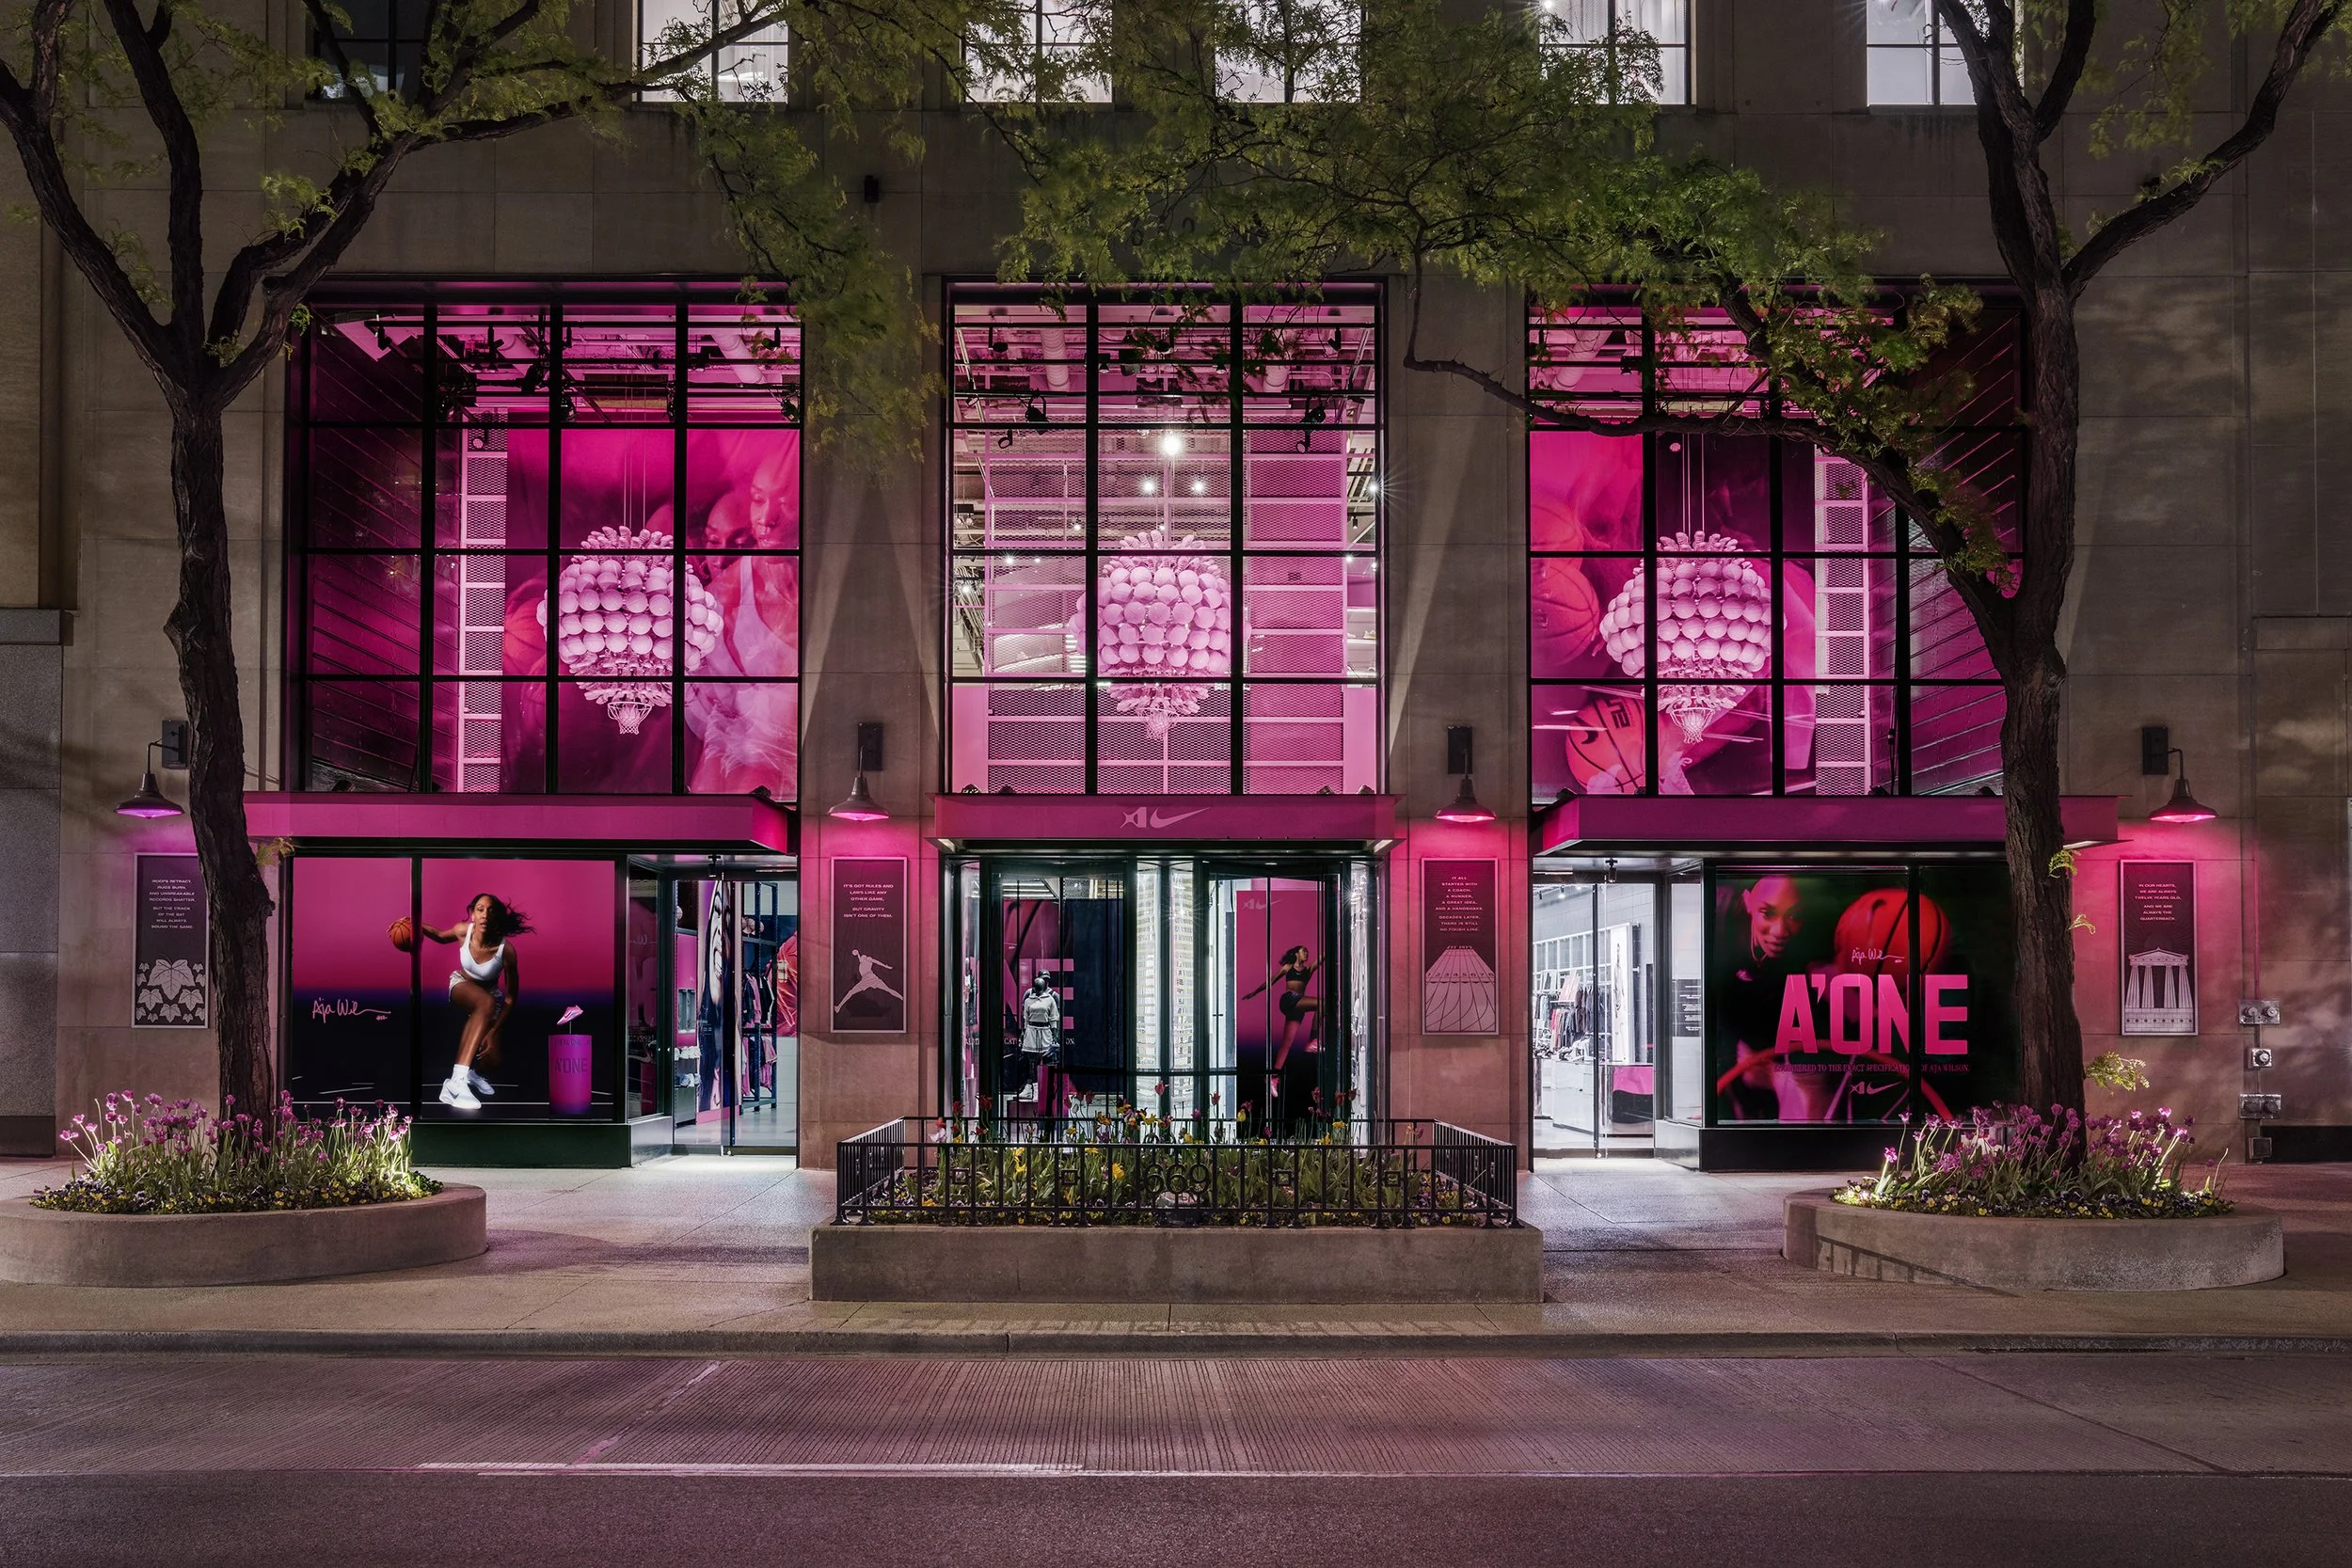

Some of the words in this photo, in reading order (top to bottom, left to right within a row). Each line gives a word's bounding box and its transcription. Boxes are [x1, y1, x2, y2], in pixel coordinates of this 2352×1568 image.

[1774, 974, 1968, 1054] A'ONE
[1818, 1064, 1827, 1072] TO
[1828, 1064, 1842, 1072] THE
[1146, 1162, 1210, 1195] 669
